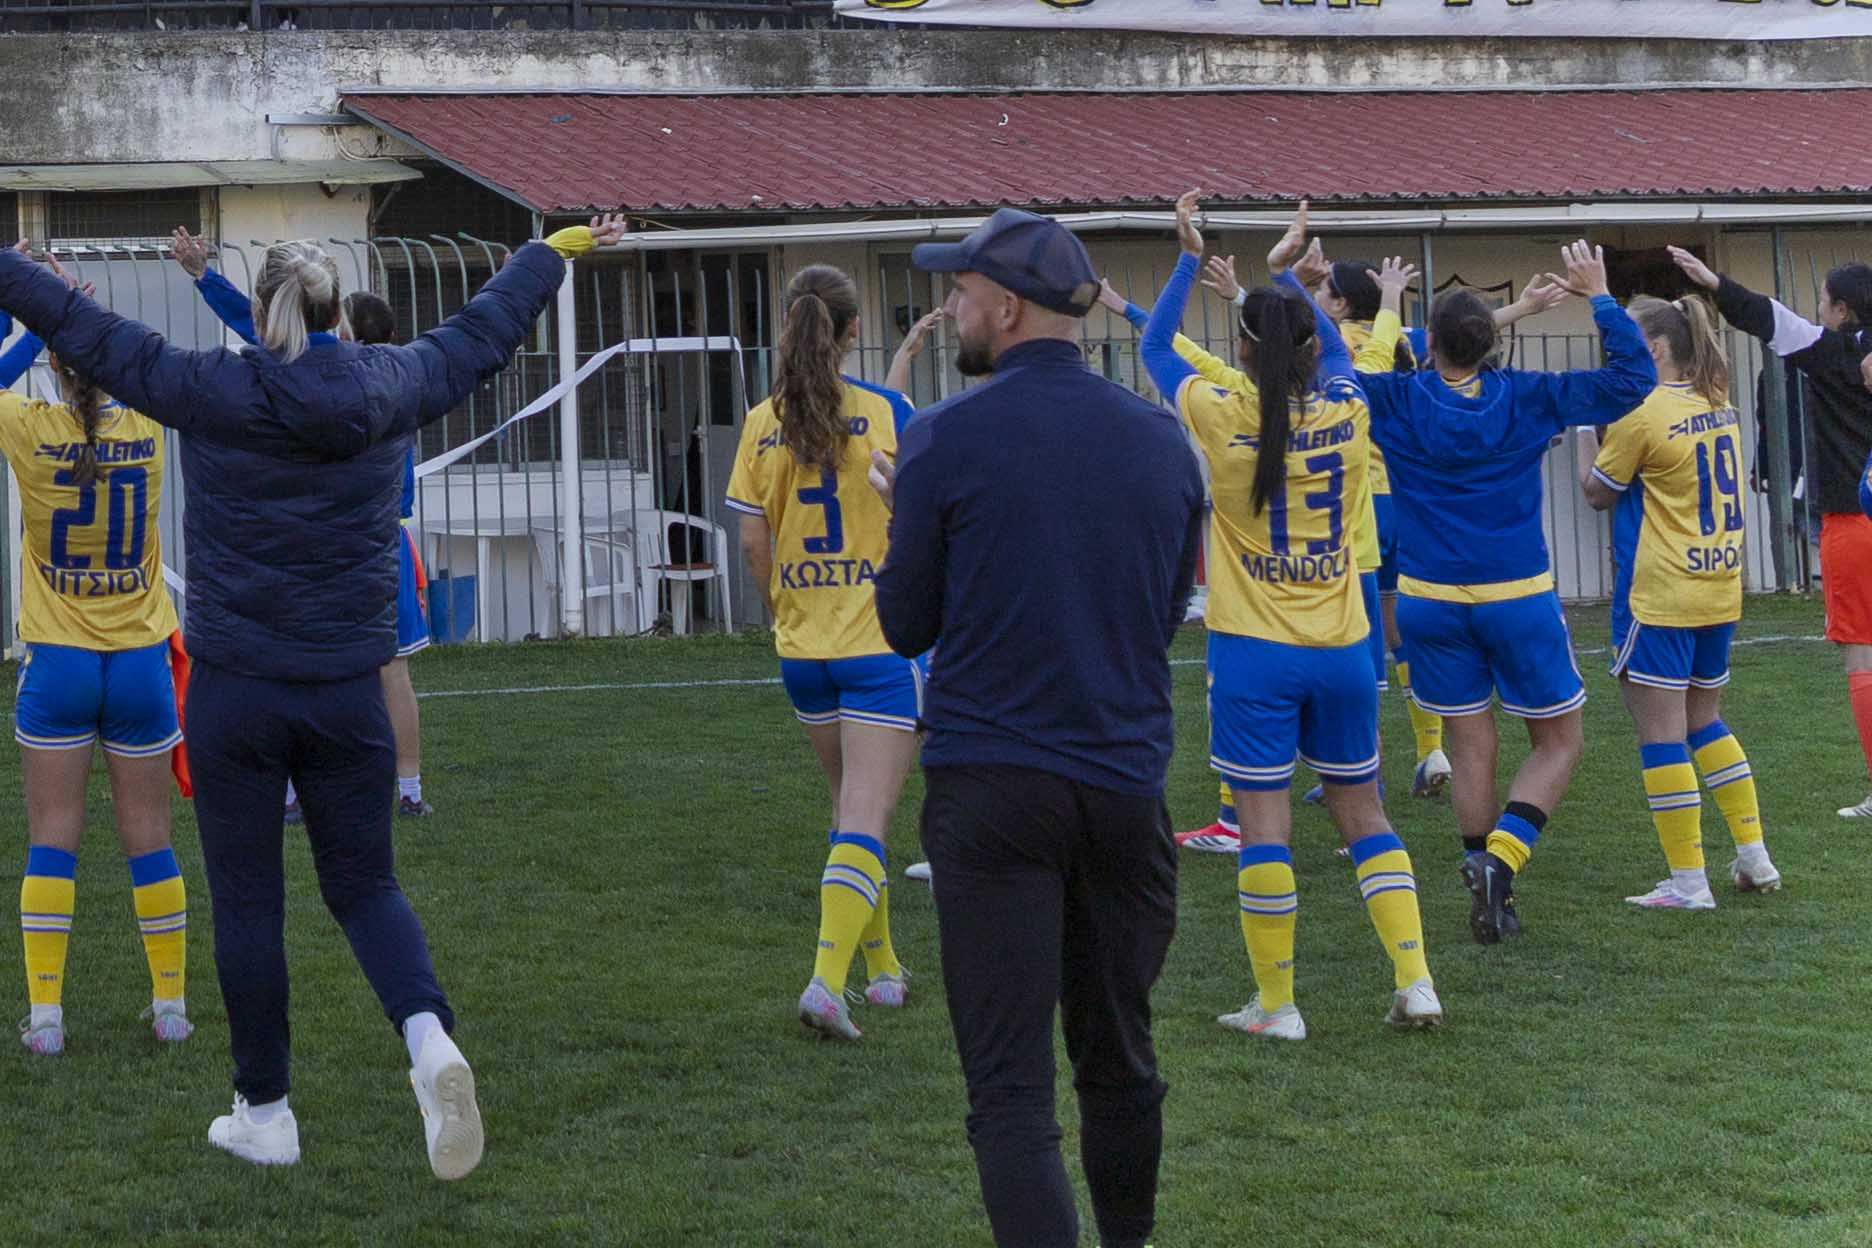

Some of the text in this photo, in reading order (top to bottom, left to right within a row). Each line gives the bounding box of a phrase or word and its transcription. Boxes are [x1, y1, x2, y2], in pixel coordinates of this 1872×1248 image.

[49, 465, 148, 570] 20
[796, 463, 844, 555] 3
[1268, 451, 1345, 556] 13
[1695, 433, 1744, 537] 19
[779, 559, 878, 590] ΚΩΣΤΑ
[1686, 538, 1743, 573] SIPÓ
